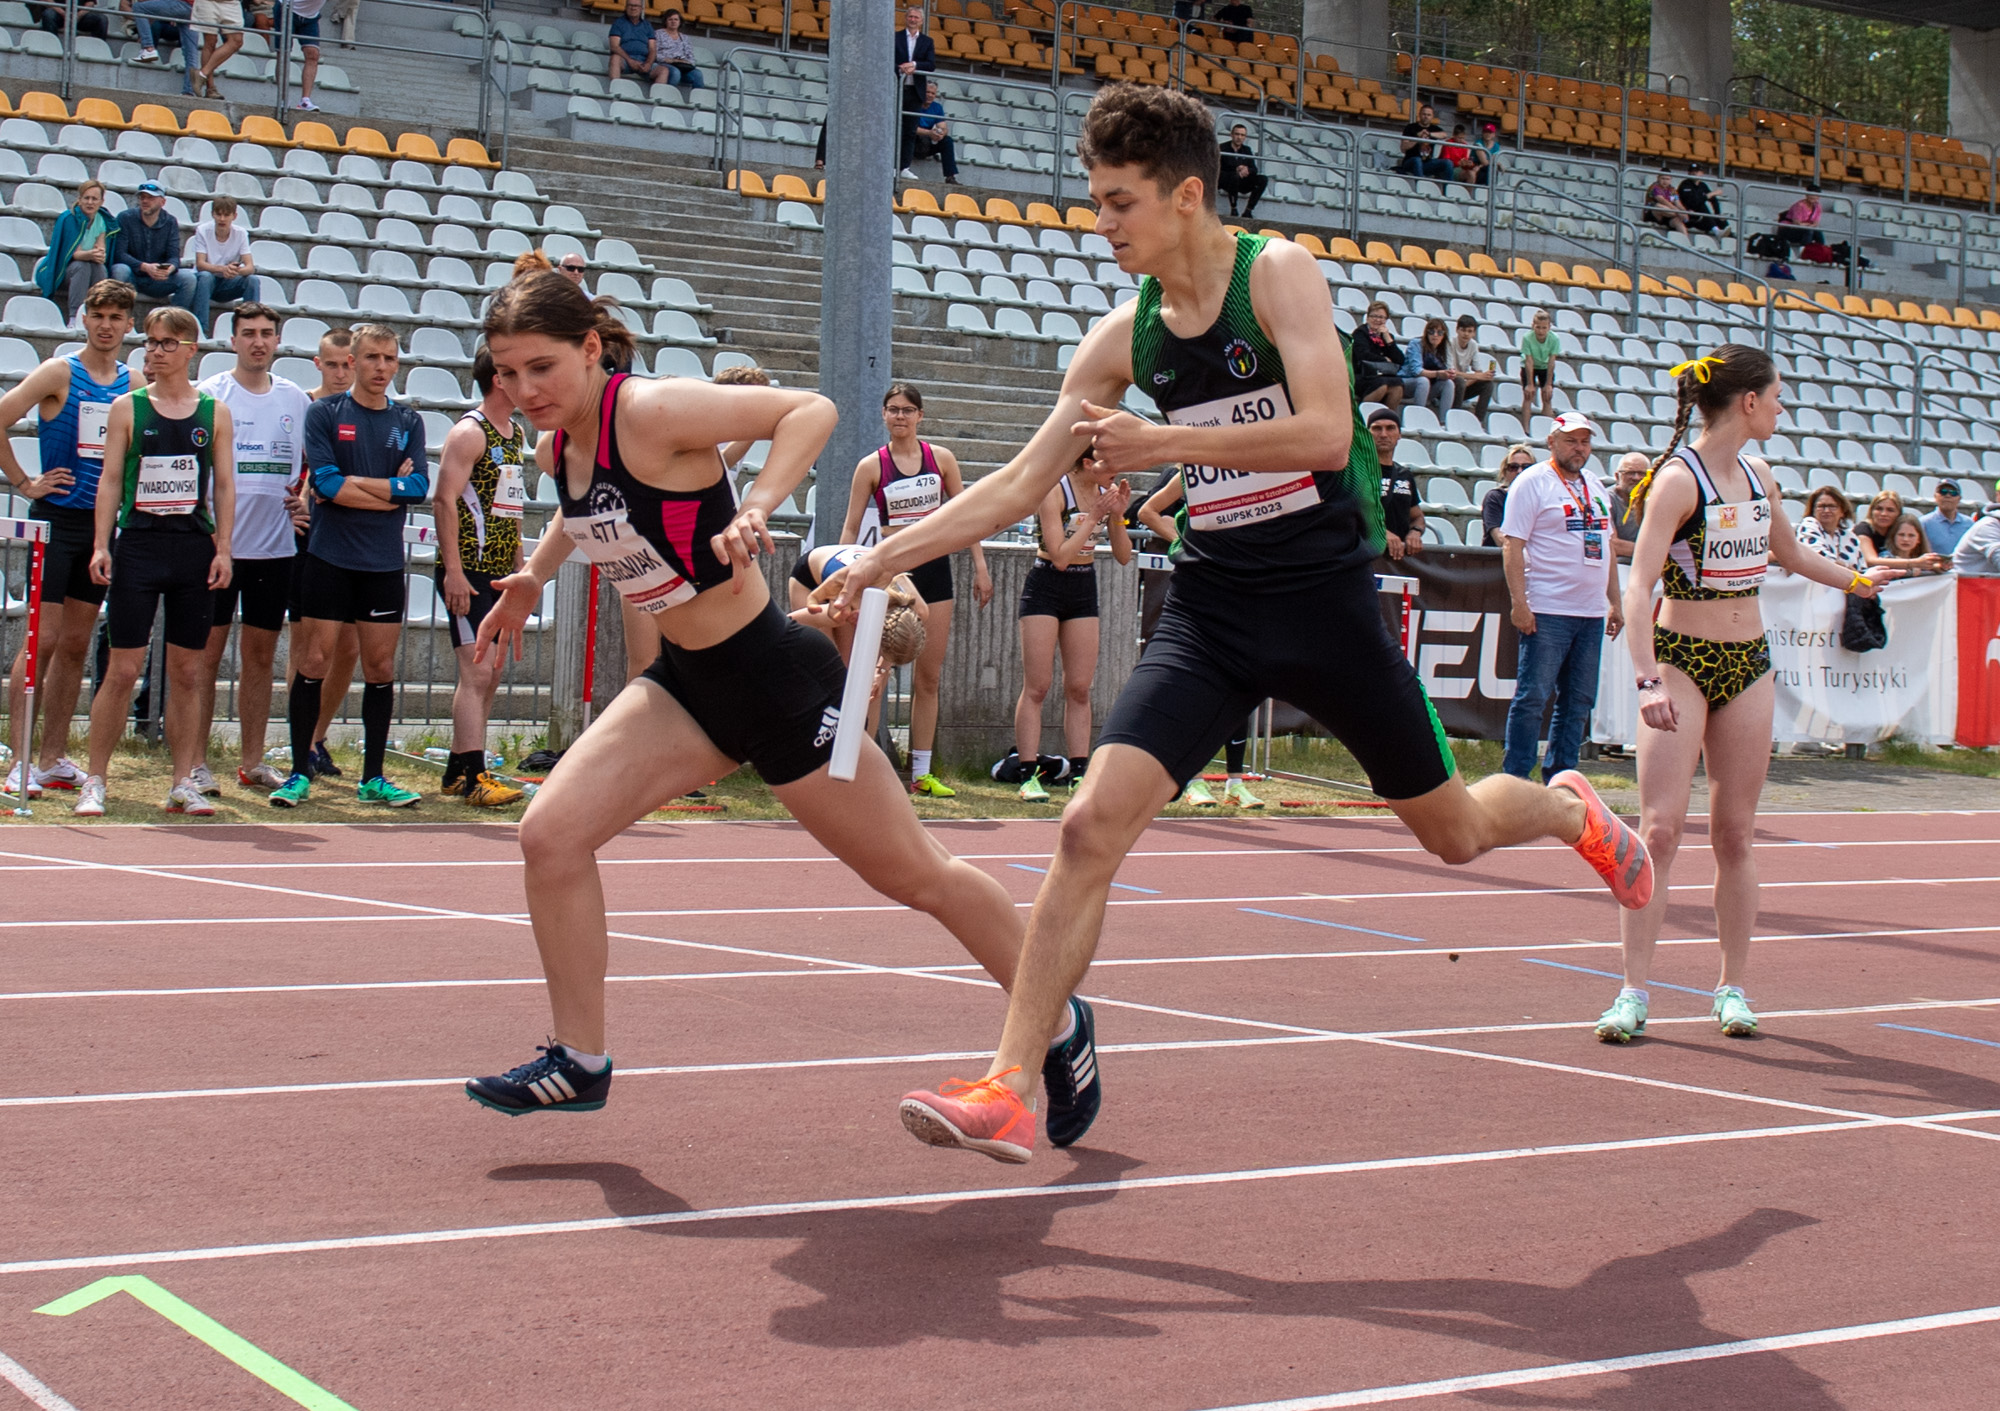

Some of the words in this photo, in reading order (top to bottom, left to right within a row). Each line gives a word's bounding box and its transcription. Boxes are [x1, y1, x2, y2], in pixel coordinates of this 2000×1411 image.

[868, 356, 876, 368] 7
[1231, 397, 1275, 425] 450
[236, 442, 264, 451] Unison
[171, 459, 194, 471] 481
[139, 480, 196, 494] TWARDOWSKI
[916, 476, 936, 488] 478
[889, 492, 939, 510] SZCZUDRAWA
[1216, 509, 1254, 525] SŁUPSK
[1254, 501, 1283, 517] 2023
[590, 519, 619, 544] 477
[1727, 579, 1752, 587] SŁUPSK
[648, 600, 668, 612] 2023
[1807, 665, 1813, 687] i
[1820, 666, 1908, 694] Turystyki
